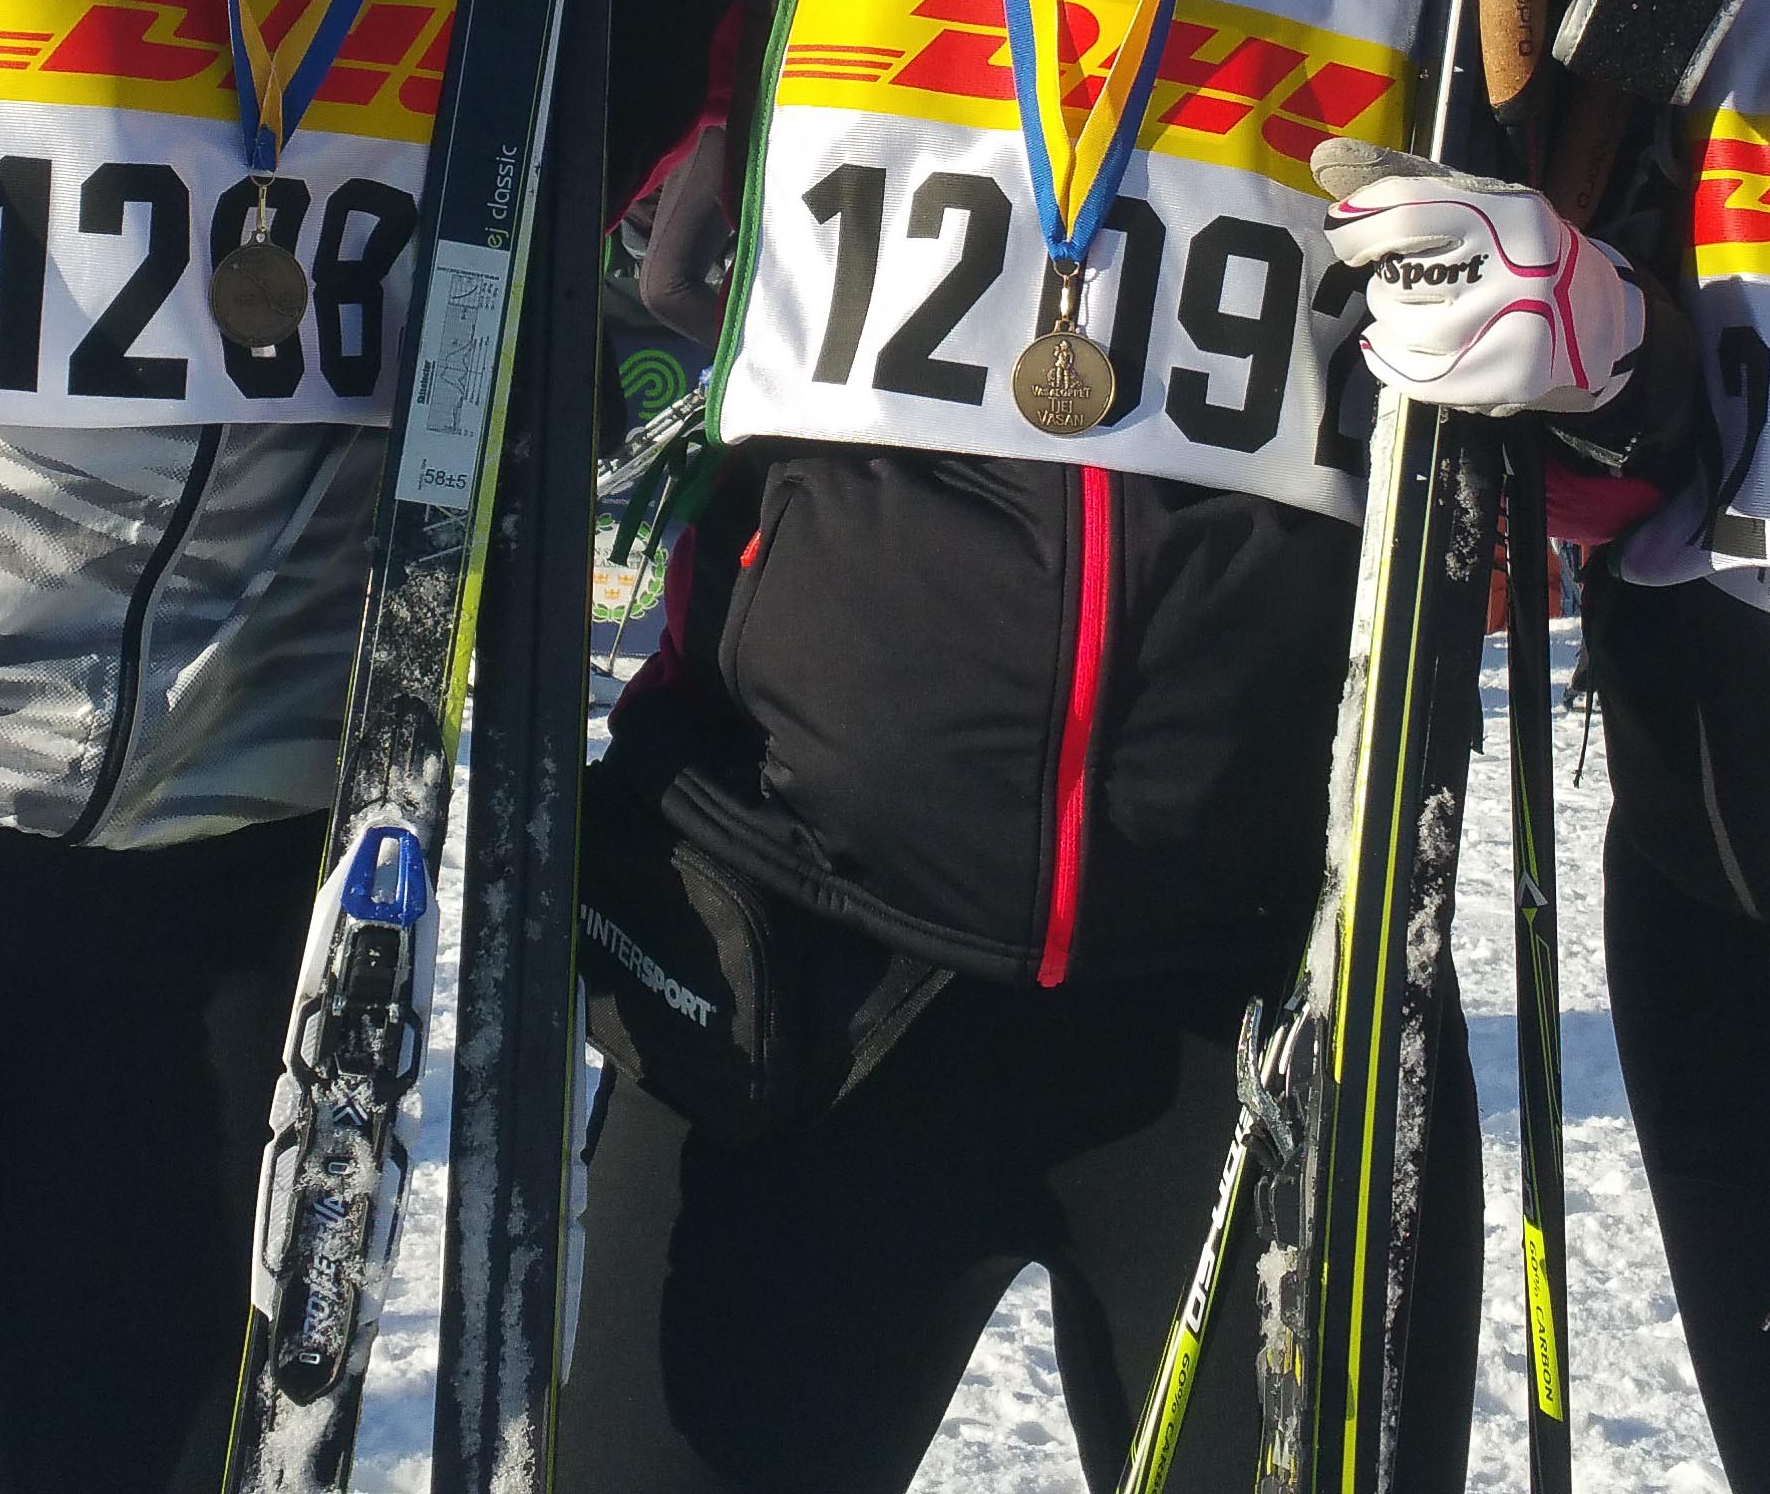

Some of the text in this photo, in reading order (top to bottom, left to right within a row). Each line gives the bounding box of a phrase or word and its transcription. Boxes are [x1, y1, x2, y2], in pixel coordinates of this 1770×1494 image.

[487, 143, 518, 220] classic
[1375, 252, 1485, 291] Sport
[802, 162, 1375, 478] 12092
[1037, 410, 1084, 426] VASAN
[1048, 396, 1074, 413] TJEJ
[586, 907, 713, 1028] INTERSPORT
[1536, 1305, 1555, 1404] CARBON
[1149, 1414, 1181, 1494] CARB
